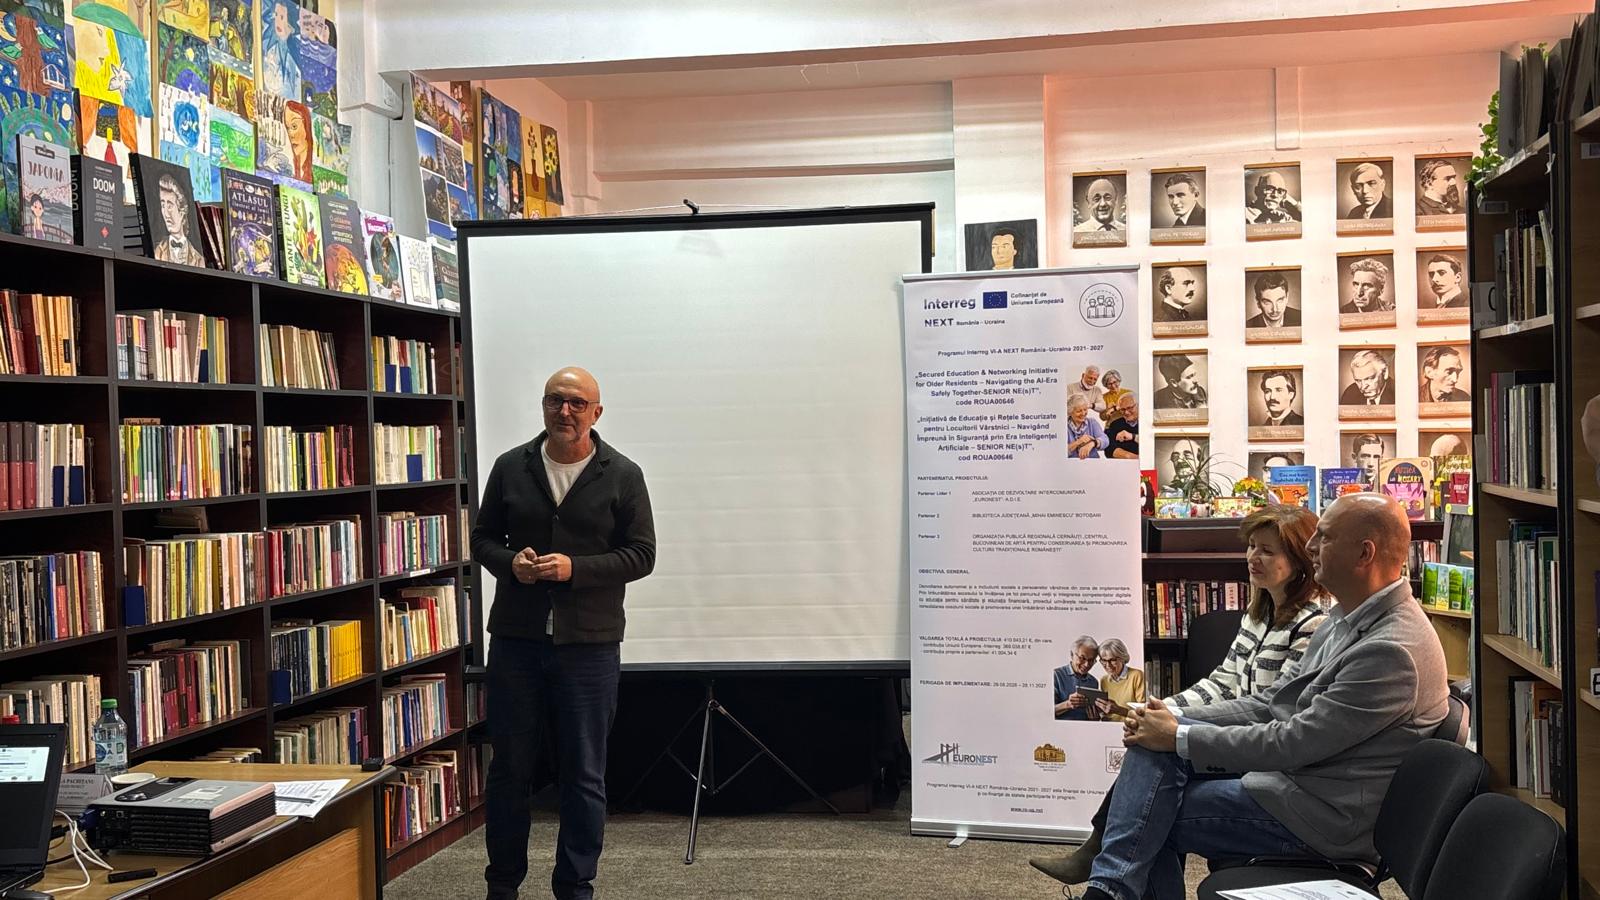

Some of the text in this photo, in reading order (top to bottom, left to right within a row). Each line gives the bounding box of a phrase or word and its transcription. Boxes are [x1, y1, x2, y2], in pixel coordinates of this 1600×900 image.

[93, 178, 116, 194] DOOM
[232, 192, 269, 207] ATLASUL
[282, 195, 291, 226] FUNGI
[285, 237, 295, 276] PLANTE
[924, 298, 976, 310] Interreg
[924, 318, 955, 328] NEXT
[984, 318, 1006, 326] Ucraina
[938, 350, 966, 358] Programul
[967, 348, 989, 356] Interreg
[1004, 347, 1020, 355] NEXT
[1090, 344, 1104, 352] 2027
[947, 369, 980, 378] Education
[988, 368, 1028, 377] Networking
[1029, 367, 1058, 375] Initiative
[926, 380, 944, 388] Older
[946, 379, 978, 387] Residents
[986, 378, 1022, 387] Navigating
[1024, 377, 1035, 385] the
[1036, 377, 1058, 385] AI-Era
[931, 389, 951, 398] Safely
[952, 387, 1011, 398] Together-SENIOR
[974, 398, 1015, 406] ROUA00646
[949, 415, 957, 423] de
[958, 415, 988, 423] Educație
[998, 414, 1019, 422] Rețele
[1021, 412, 1057, 421] Securizate
[924, 426, 945, 434] pentru
[979, 424, 1010, 432] Vârstnici
[1017, 422, 1050, 432] Navigând
[956, 434, 989, 443] Siguranță
[990, 433, 1004, 442] prin
[1006, 433, 1018, 441] Era
[1019, 432, 1058, 442] Inteligenței
[938, 444, 969, 452] Artificiale
[977, 443, 1004, 451] SENIOR
[973, 453, 1014, 462] ROUA00646
[953, 754, 999, 764] EURONEST
